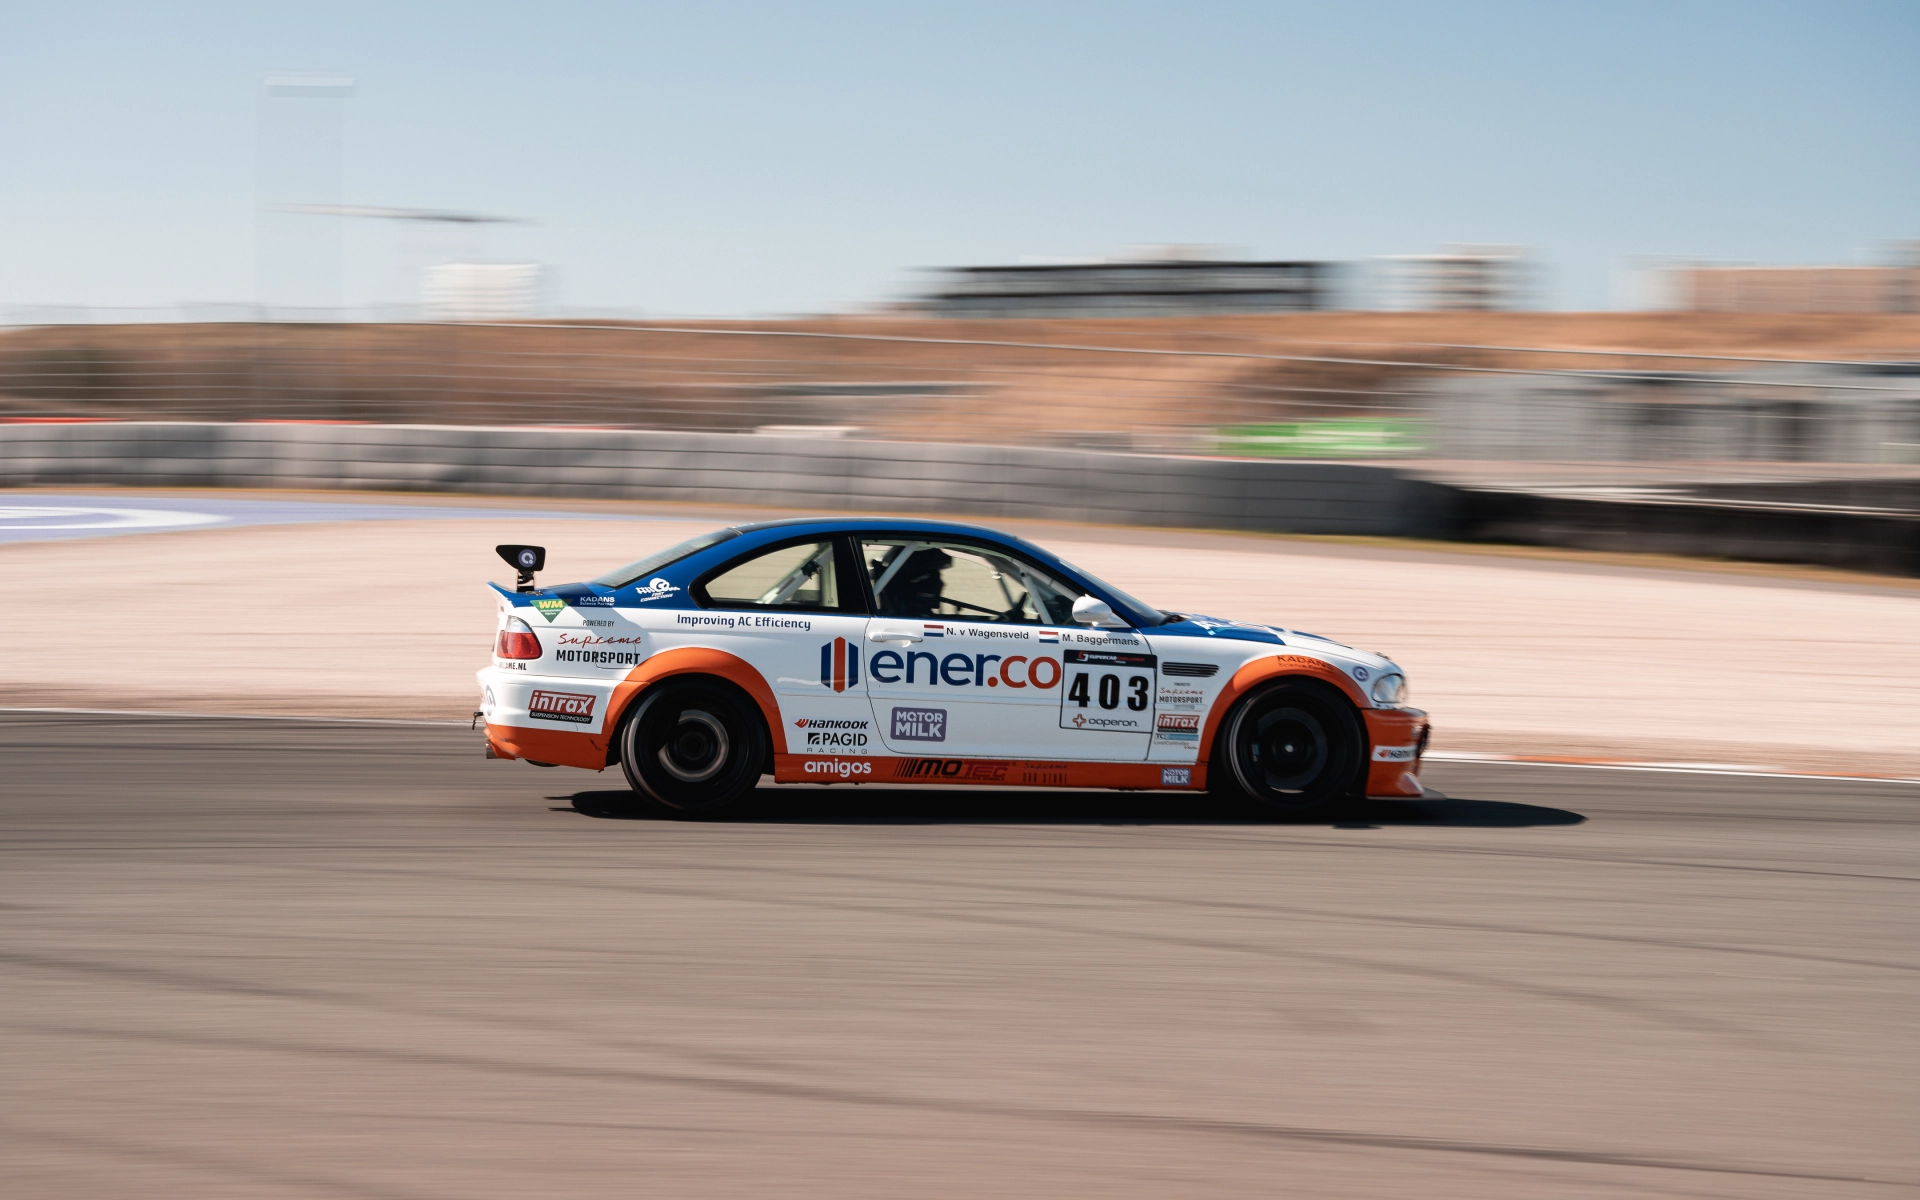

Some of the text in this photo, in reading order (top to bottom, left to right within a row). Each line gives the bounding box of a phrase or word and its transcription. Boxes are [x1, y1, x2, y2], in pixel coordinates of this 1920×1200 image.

[538, 600, 563, 609] WM
[677, 614, 811, 631] Improving AC Efficiency
[557, 633, 642, 648] Supreme
[968, 629, 1029, 640] Wagensveld
[1062, 634, 1140, 647] M. Baggermans
[556, 649, 640, 665] MOTORSPORT
[869, 650, 1062, 690] ener.co
[1068, 672, 1149, 711] 403
[896, 710, 943, 722] MOTOR
[896, 722, 942, 738] MILK
[822, 732, 868, 746] PAGID
[804, 758, 872, 778] amigos
[1163, 775, 1189, 784] MILK
